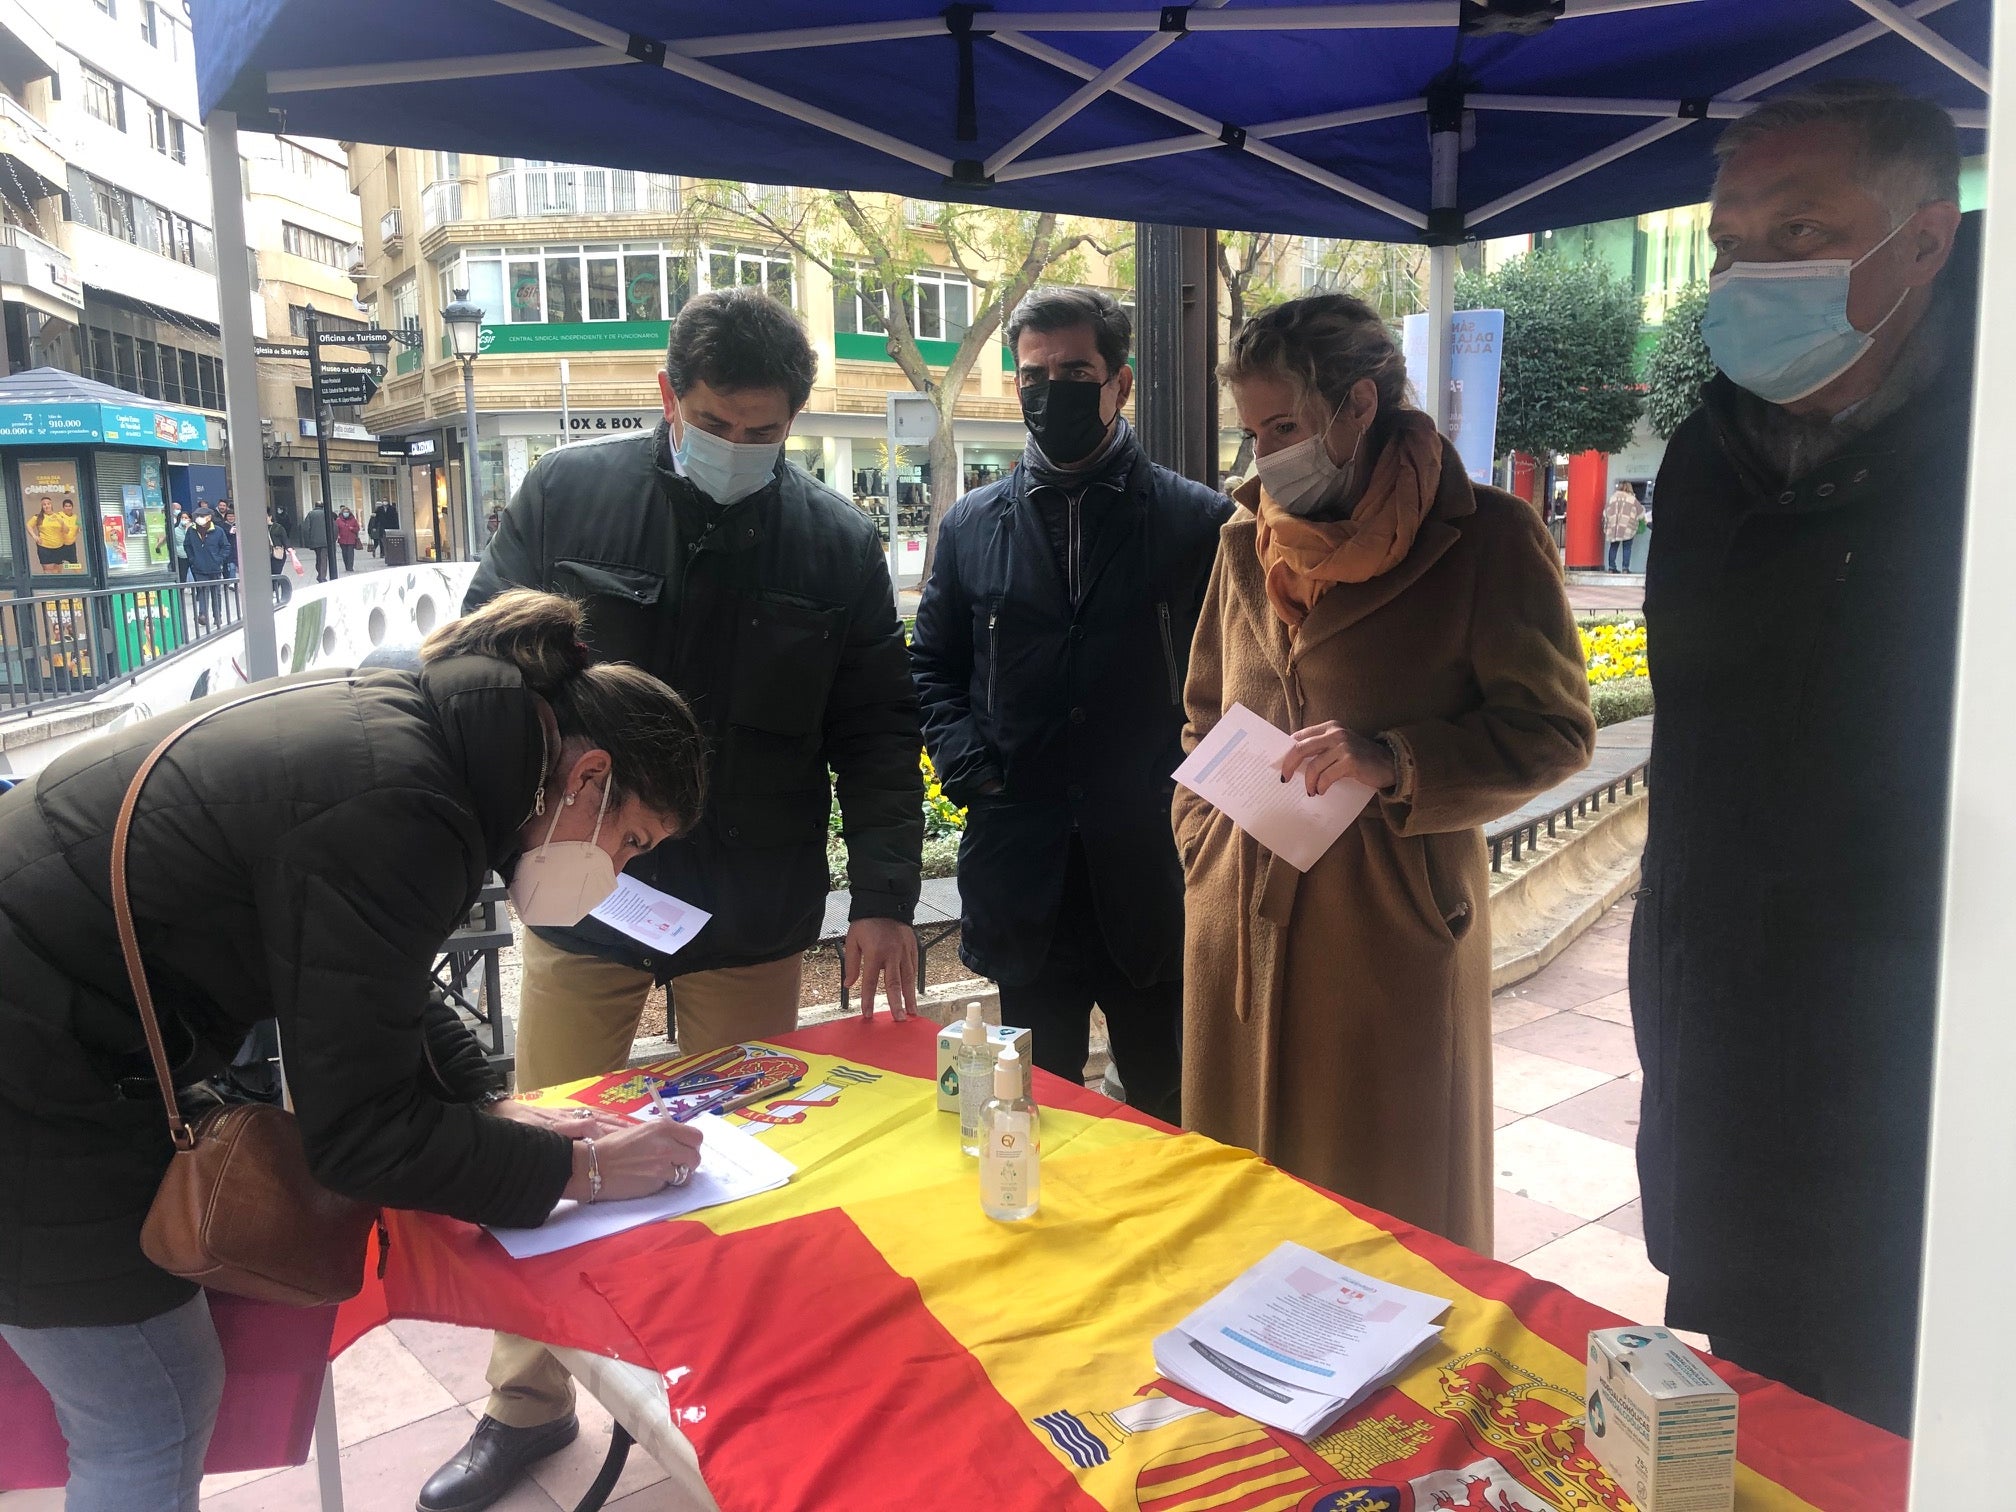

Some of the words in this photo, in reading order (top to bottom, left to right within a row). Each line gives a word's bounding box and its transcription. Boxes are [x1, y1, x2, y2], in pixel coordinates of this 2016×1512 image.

[319, 334, 346, 342] Oficina
[356, 333, 387, 342] Turismo
[321, 365, 341, 373] Museo
[23, 414, 33, 422] 75
[49, 420, 82, 428] 910.000
[596, 417, 607, 429] &
[611, 417, 643, 429] BOX
